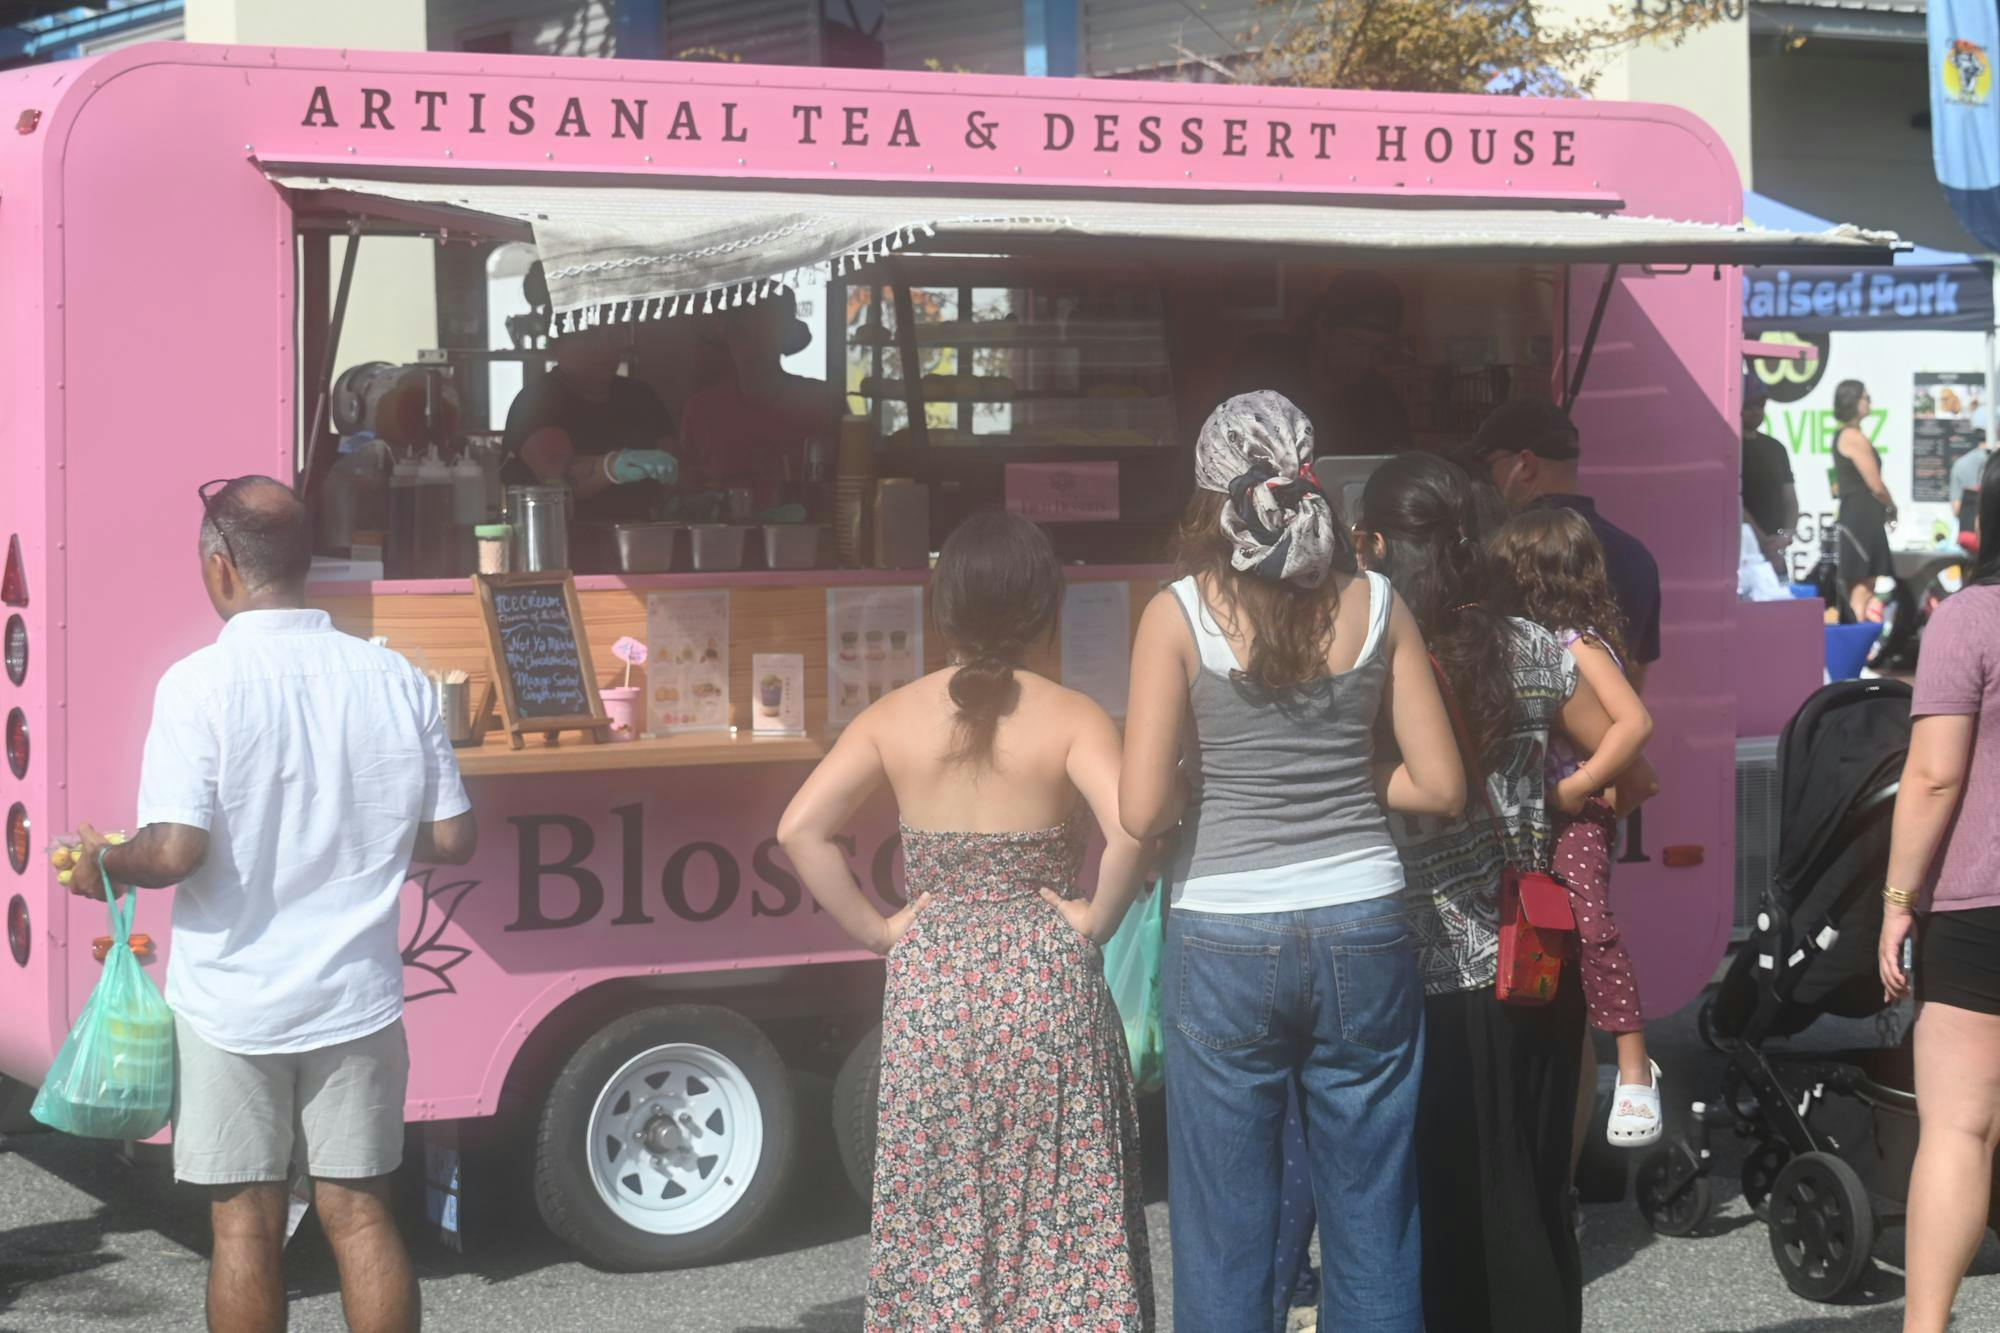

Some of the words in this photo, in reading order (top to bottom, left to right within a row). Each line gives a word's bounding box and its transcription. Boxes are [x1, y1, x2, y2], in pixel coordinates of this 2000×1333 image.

[301, 85, 748, 144] ARTISANAL
[792, 105, 921, 148] TEA
[964, 109, 1000, 151] &
[1042, 112, 1337, 160] DESSERT
[1376, 125, 1576, 167] HOUSE
[1868, 272, 1960, 317] Pork
